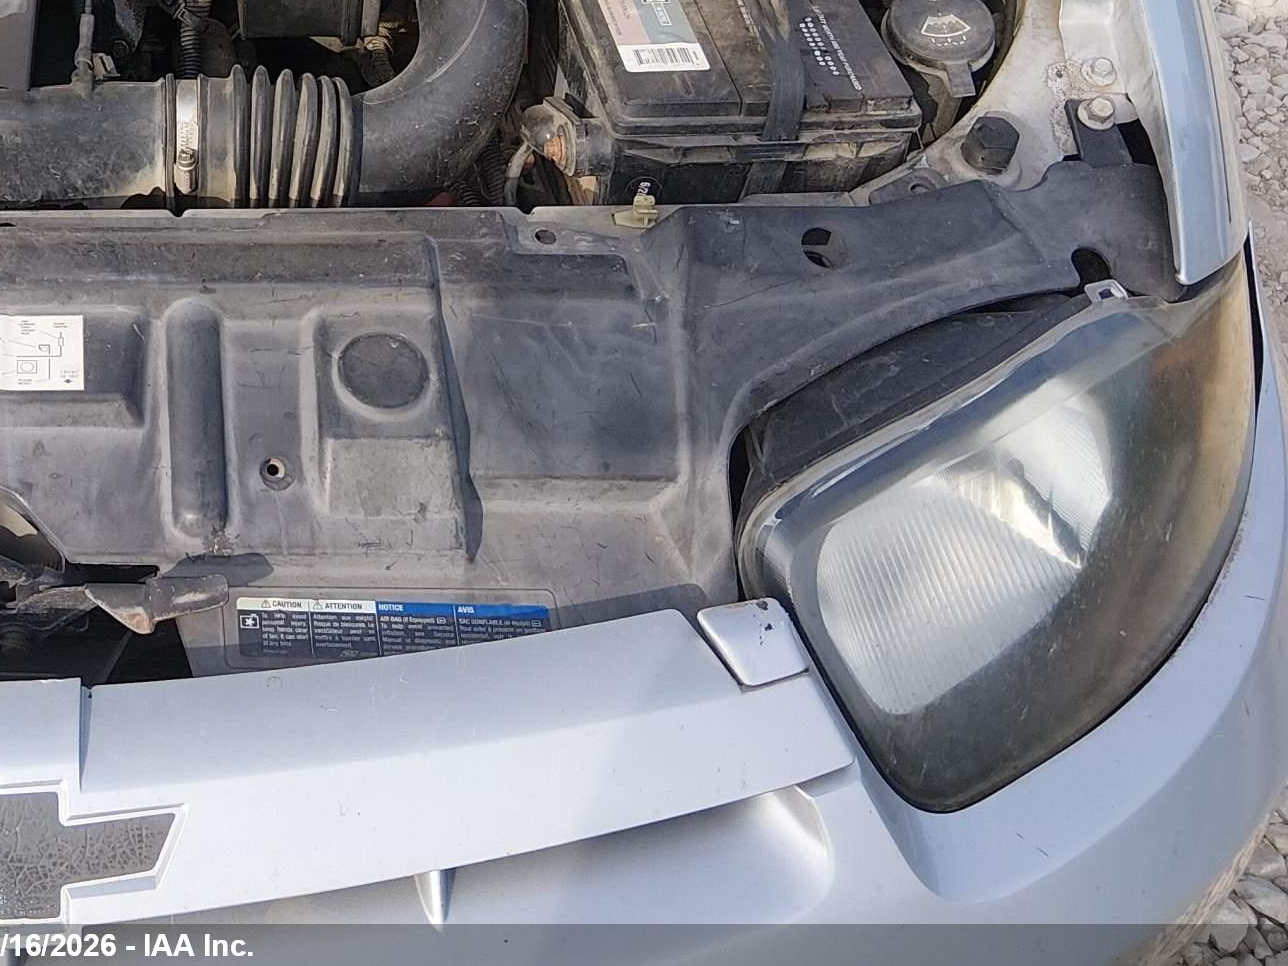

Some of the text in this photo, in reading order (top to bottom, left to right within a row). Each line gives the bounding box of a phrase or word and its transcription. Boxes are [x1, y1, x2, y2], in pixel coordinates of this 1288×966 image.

[272, 601, 302, 609] CAUTION
[378, 604, 403, 612] NOTICE
[458, 606, 474, 614] AVIS
